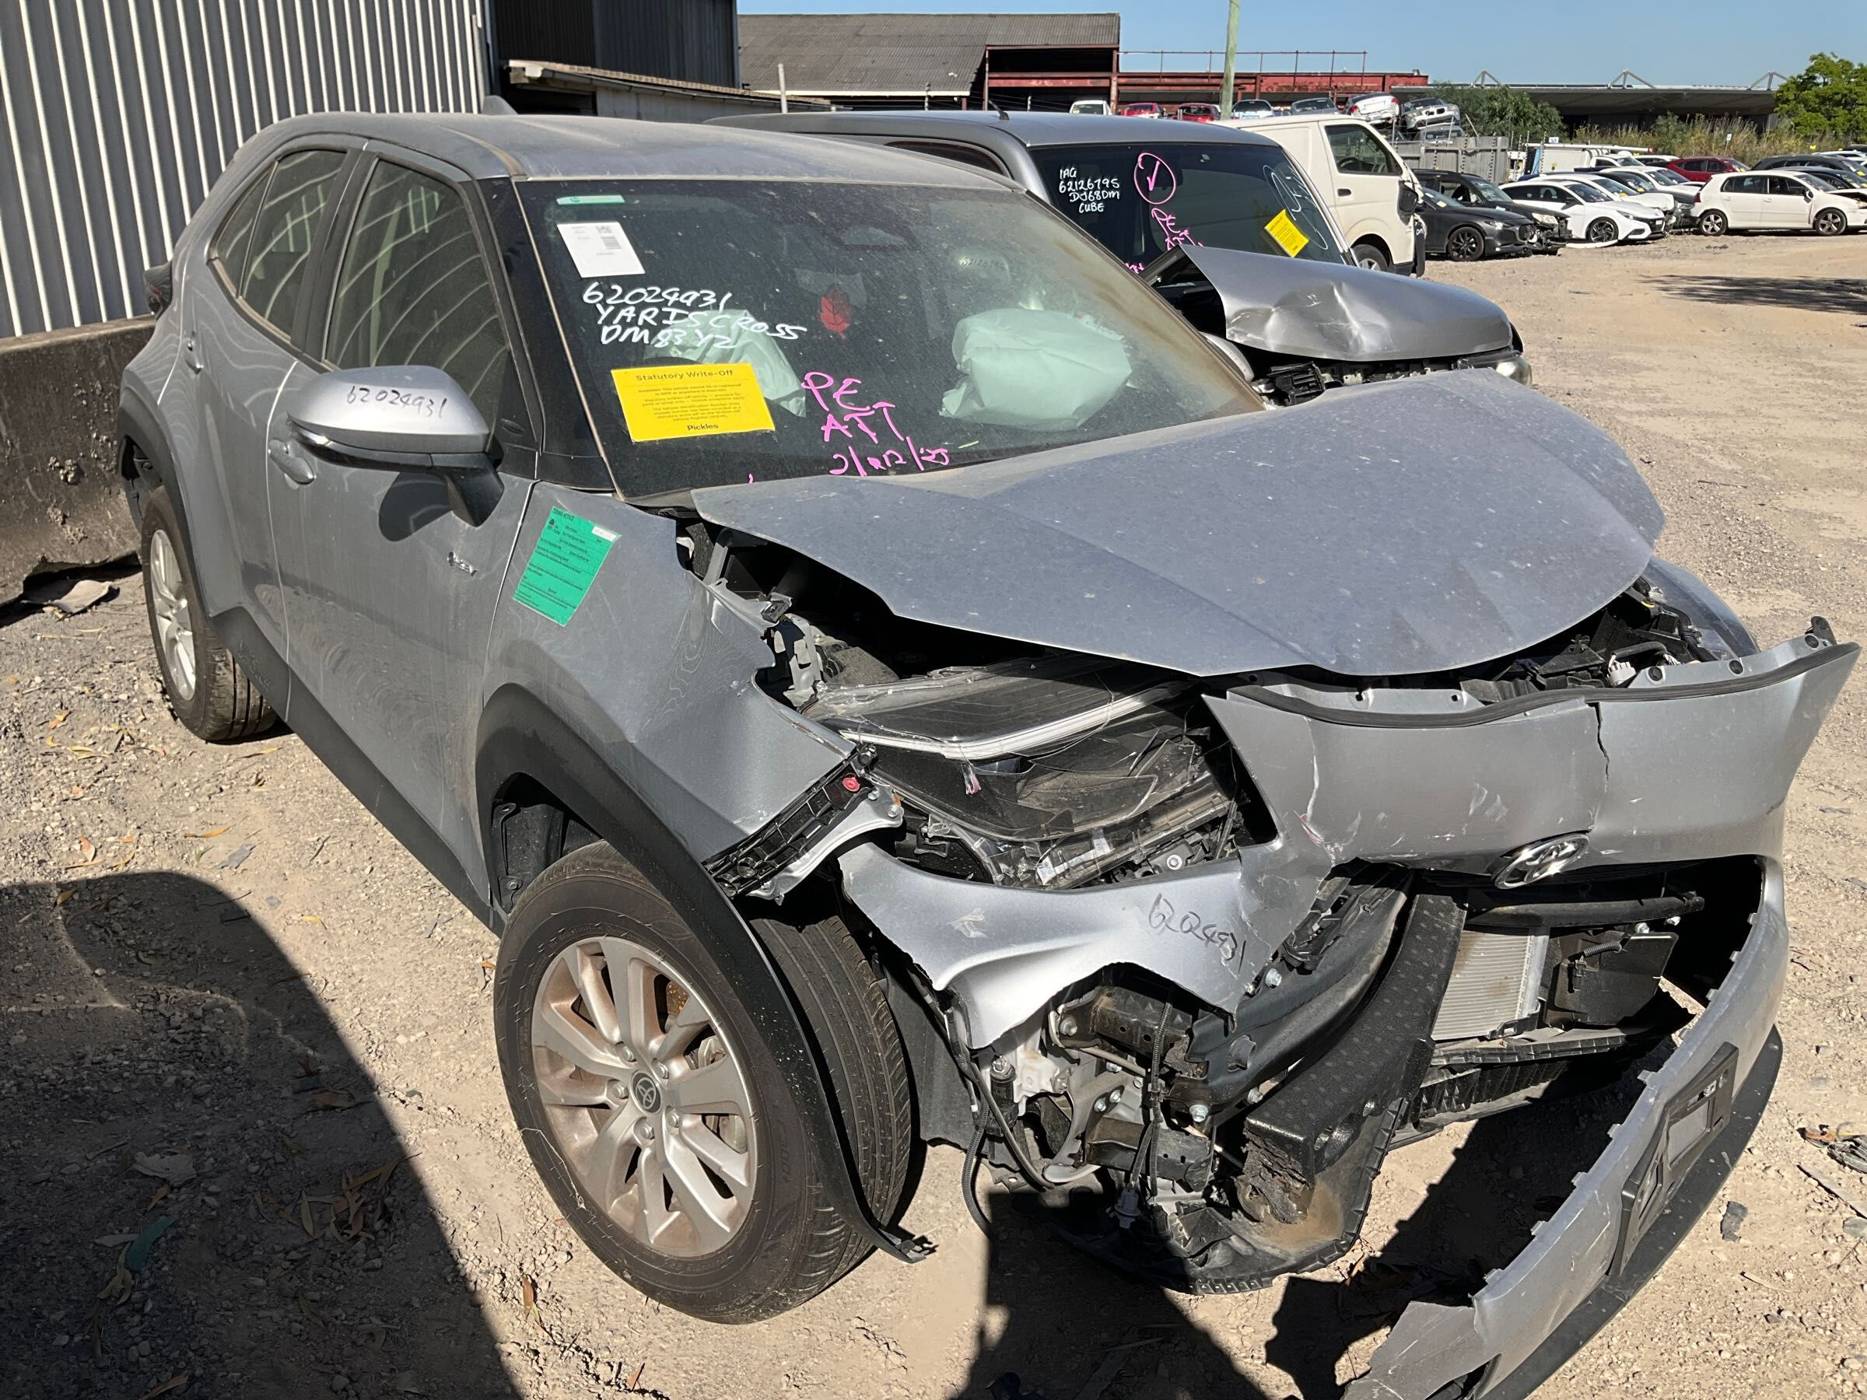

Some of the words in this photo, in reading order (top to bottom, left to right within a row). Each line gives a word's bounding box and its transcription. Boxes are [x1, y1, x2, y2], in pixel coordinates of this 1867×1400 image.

[1059, 166, 1077, 180] IAG
[1078, 202, 1105, 214] CUBE
[596, 303, 709, 328] YARIS
[709, 313, 808, 340] CROSS
[636, 373, 685, 382] Statutory
[686, 369, 734, 378] Write-Off
[346, 385, 448, 418] 62024931
[687, 423, 720, 432] Pickles
